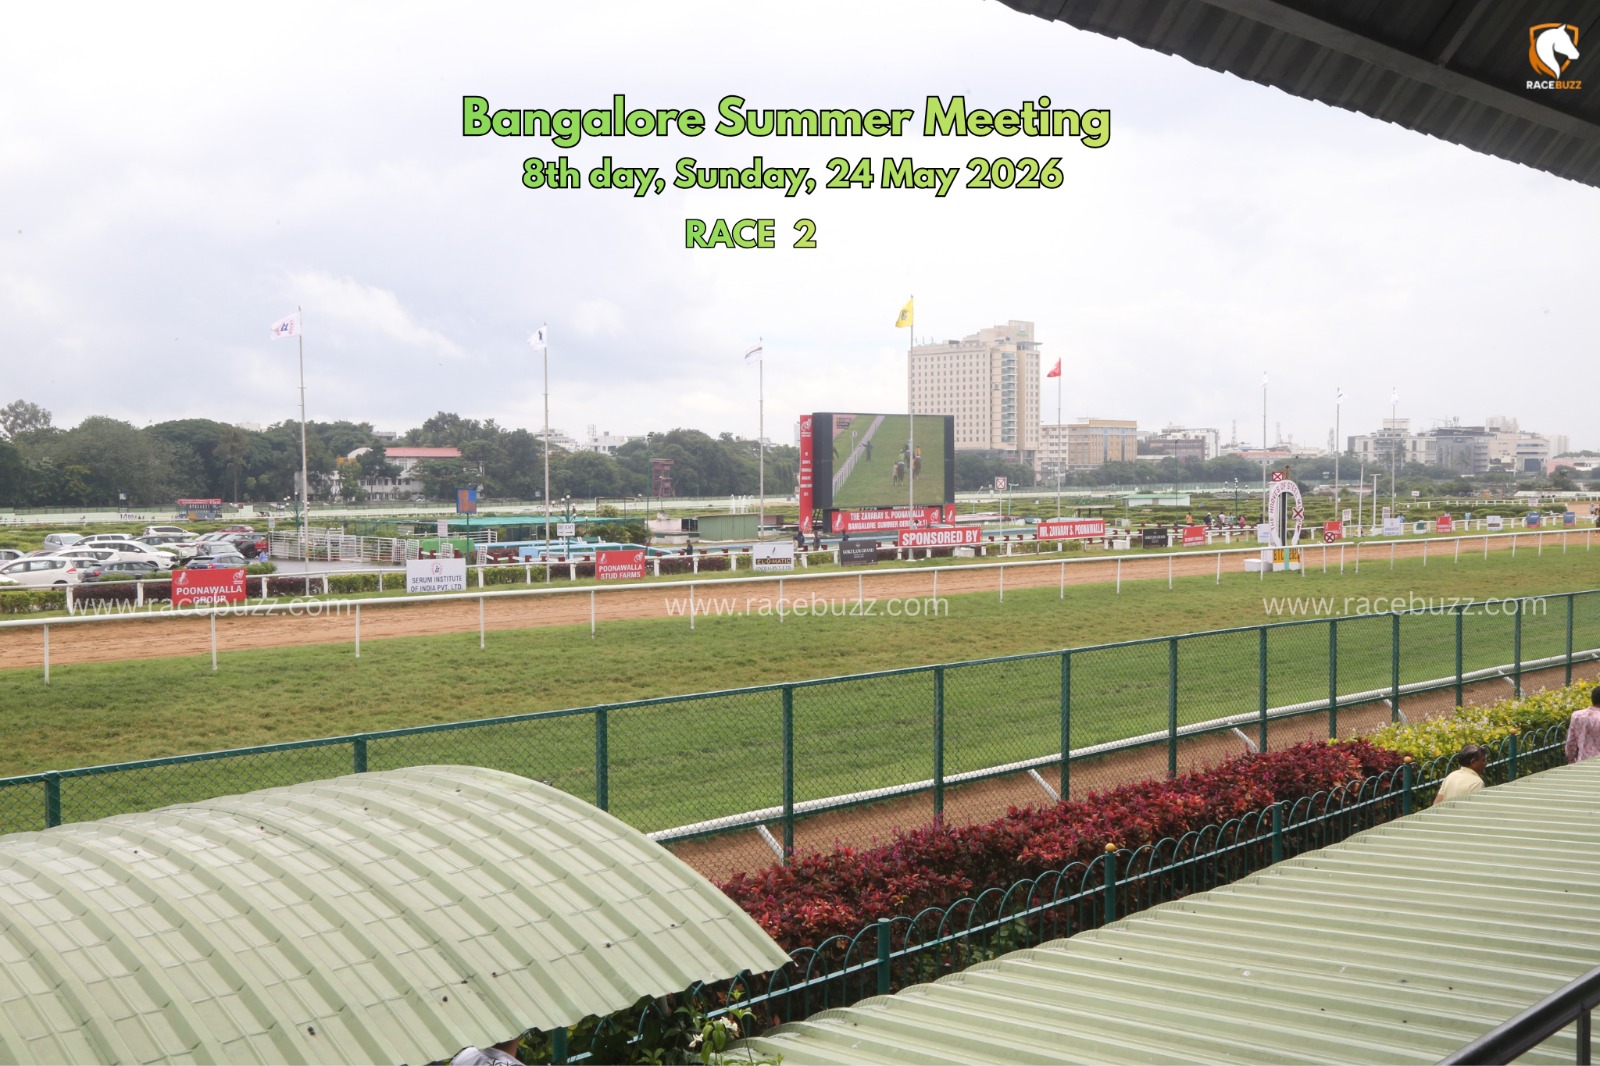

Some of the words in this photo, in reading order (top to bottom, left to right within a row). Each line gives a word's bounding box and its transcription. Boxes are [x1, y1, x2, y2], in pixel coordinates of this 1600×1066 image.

[848, 521, 876, 530] BANGALORE
[902, 531, 963, 546] SPONSORED
[965, 529, 978, 543] BY
[599, 564, 642, 572] POONAWALLA
[412, 576, 433, 584] SERUM
[433, 575, 463, 583] INSTITUTE
[600, 572, 618, 580] STUD
[176, 585, 243, 595] POONAWALLA
[420, 584, 436, 592] INDIA
[193, 595, 227, 604] GROUP
